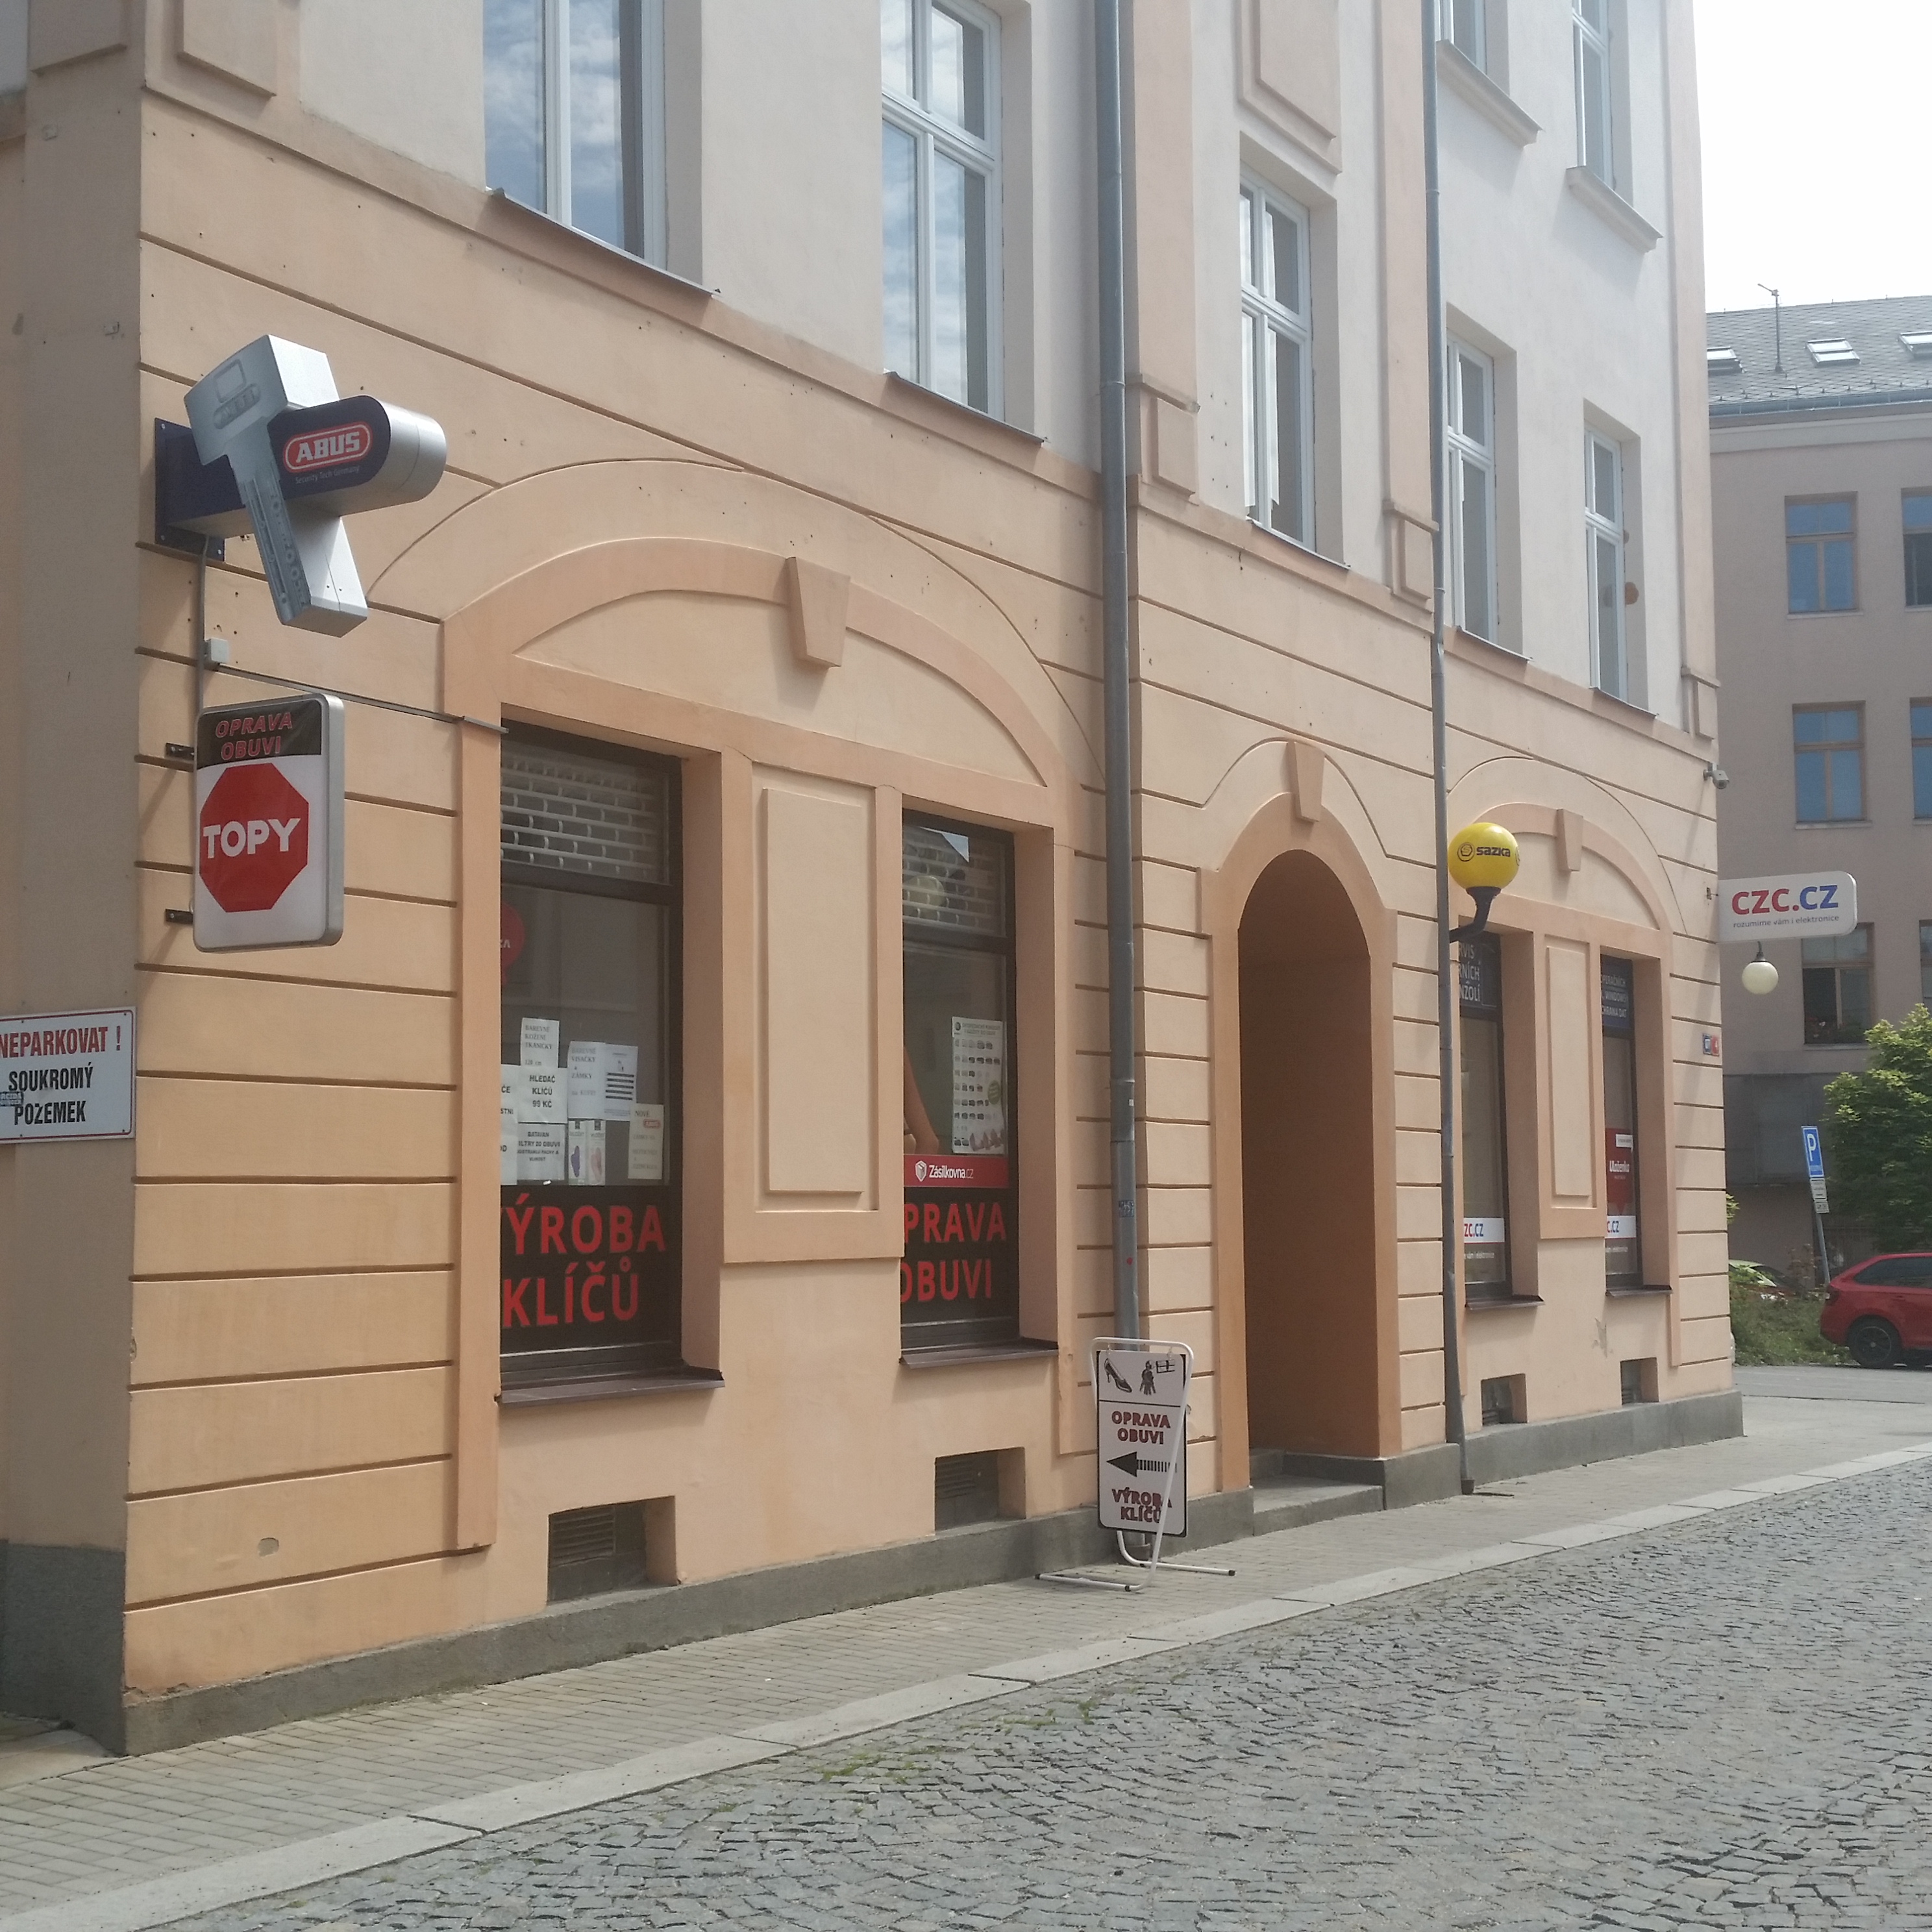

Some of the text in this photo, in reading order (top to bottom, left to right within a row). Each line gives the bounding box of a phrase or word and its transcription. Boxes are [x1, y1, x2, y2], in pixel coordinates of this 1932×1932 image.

[296, 432, 360, 463] ABUS
[295, 474, 318, 484] Security
[216, 712, 293, 738] OPRAVA
[221, 736, 282, 760] OBUVI
[203, 818, 301, 858] TOPY
[1731, 885, 1839, 915] CZC.CZ
[1796, 915, 1839, 924] elektronice
[0, 1026, 108, 1058] NEPARKOVAT
[8, 1061, 93, 1092] SOUKROMÝ
[14, 1100, 86, 1126] POZEMEK
[1807, 1133, 1816, 1161] P
[501, 1193, 667, 1255] ÝROBA
[502, 1256, 639, 1328] KLÍČŮ
[1111, 1411, 1171, 1428] OPRAVA
[1117, 1428, 1164, 1444] OBUVI
